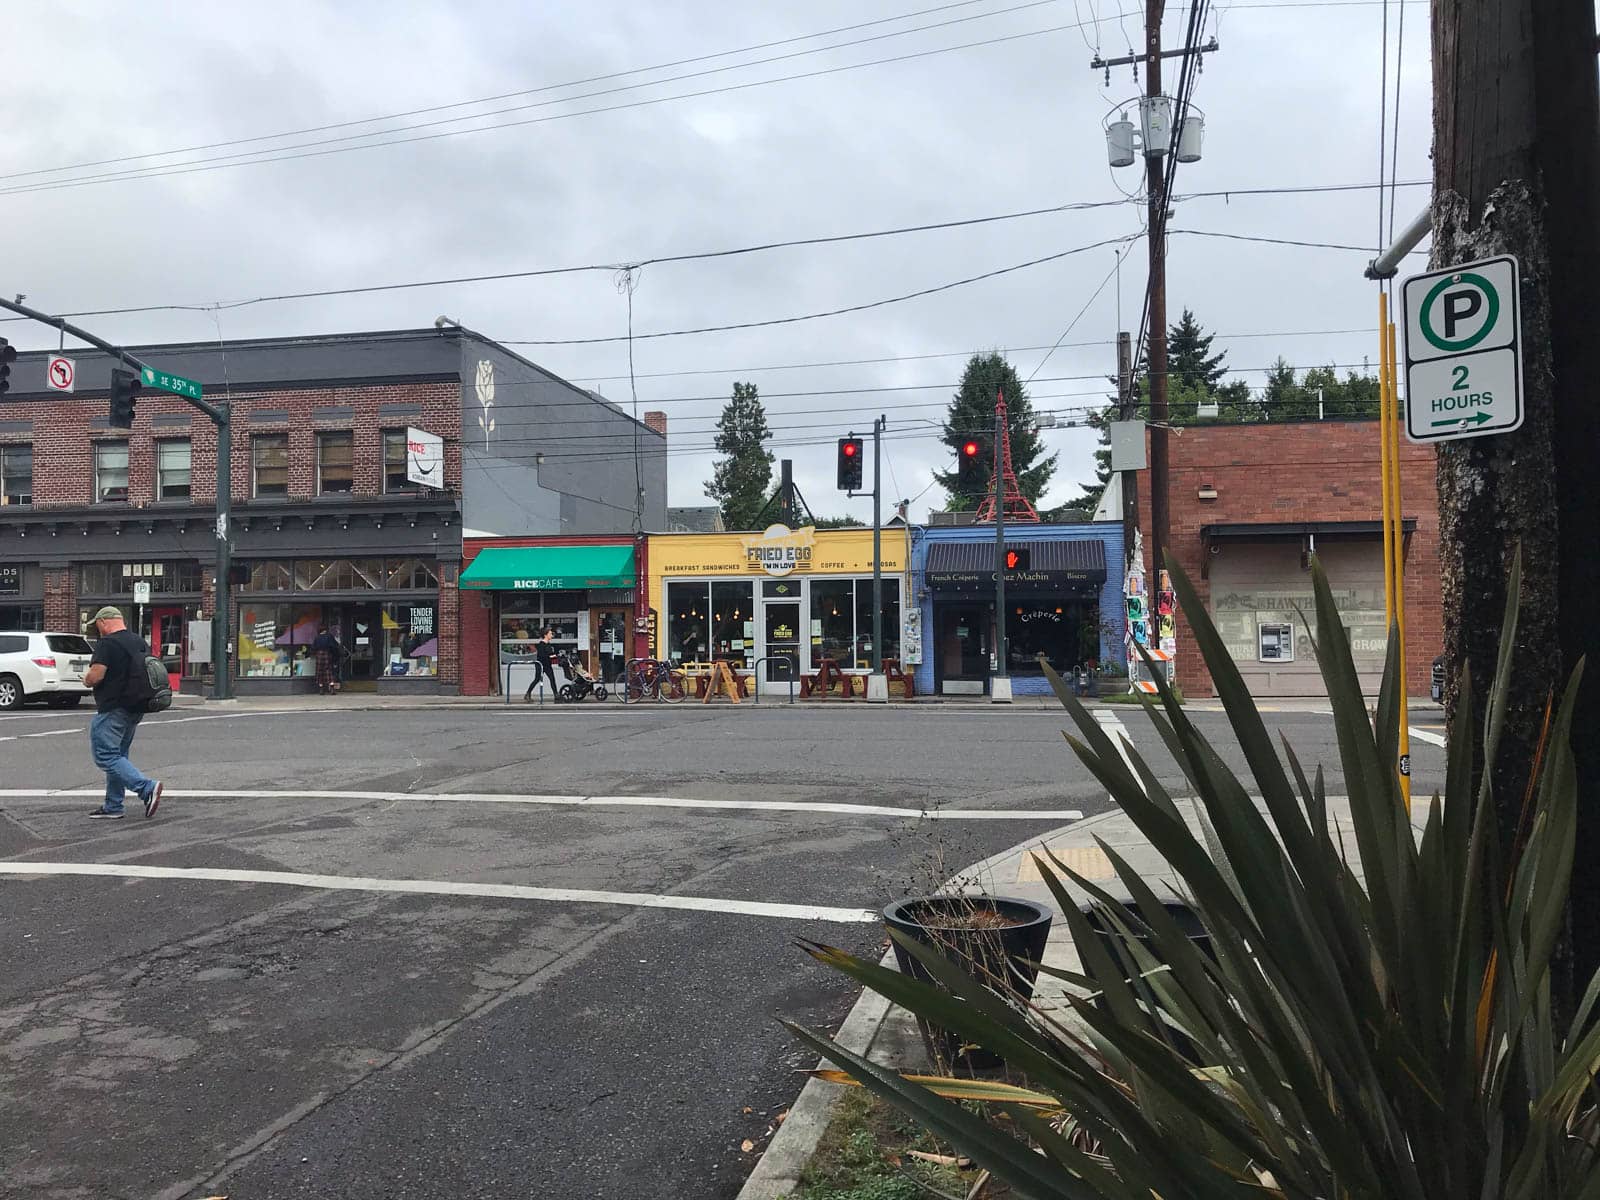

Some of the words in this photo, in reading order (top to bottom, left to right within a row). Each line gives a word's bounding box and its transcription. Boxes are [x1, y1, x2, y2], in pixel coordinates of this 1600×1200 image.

[1443, 289, 1481, 338] P
[1451, 365, 1470, 391] 2
[161, 376, 169, 386] SE
[189, 385, 197, 396] PL
[1431, 391, 1494, 412] HOURS
[408, 441, 425, 455] RICE
[747, 547, 783, 561] FRIED
[786, 547, 812, 561] EGG
[991, 572, 1015, 581] Cez
[1016, 572, 1048, 581] Machin
[1266, 597, 1349, 610] HAWTHNE
[410, 607, 433, 616] TENDER
[411, 617, 433, 625] LOVING
[411, 625, 433, 634] EMPIRE
